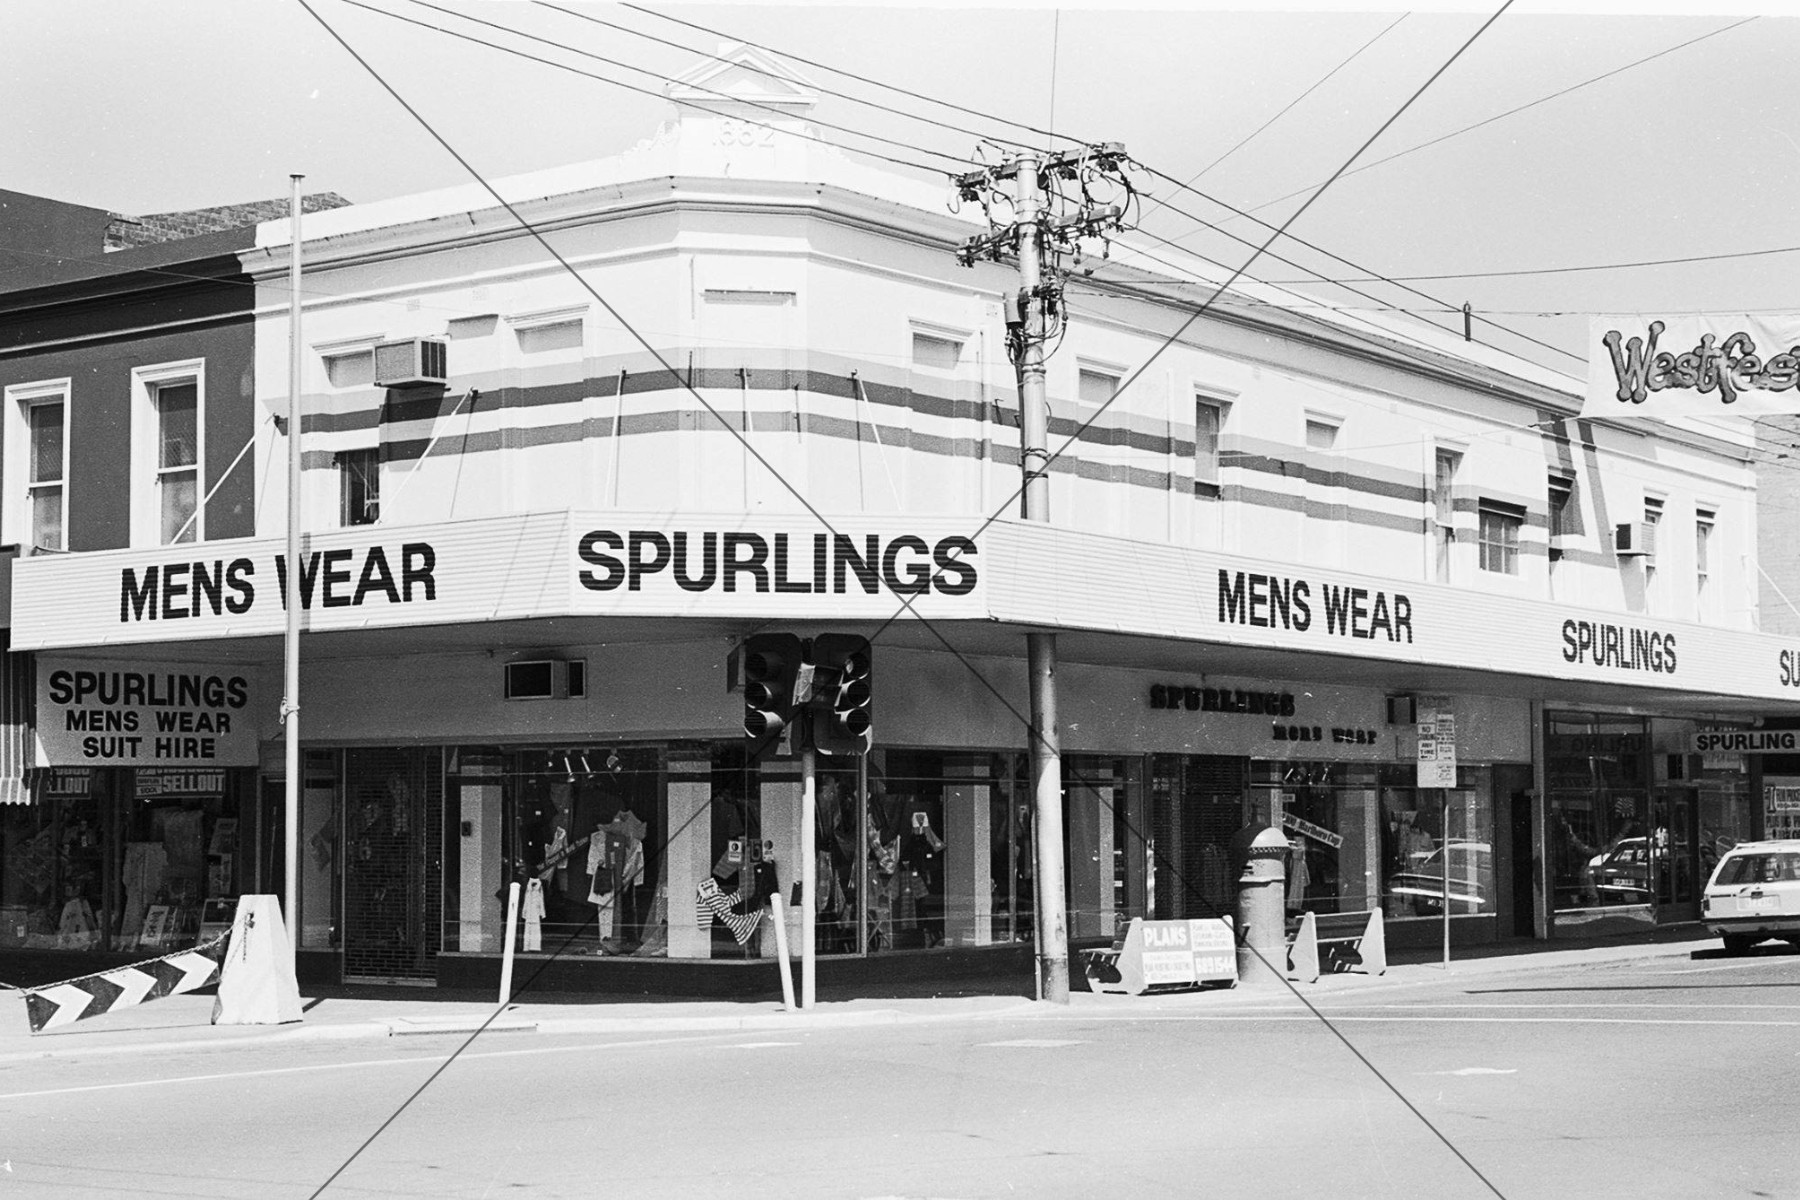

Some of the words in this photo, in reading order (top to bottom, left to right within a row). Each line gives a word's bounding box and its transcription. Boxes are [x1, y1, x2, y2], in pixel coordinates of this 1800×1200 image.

[713, 120, 774, 147] 882
[1602, 320, 1800, 404] Westfes
[578, 530, 978, 596] SPURLINGS
[121, 557, 255, 622] MENS
[275, 542, 437, 611] WEAR
[1219, 569, 1312, 632] MENS
[1322, 583, 1413, 643] WEAR
[1563, 619, 1677, 673] SPURLINGS
[49, 670, 248, 709] SPURLINGS
[1148, 683, 1296, 716] SPURLINGS
[66, 709, 139, 732] MENS
[156, 711, 231, 734] WEAR
[83, 737, 143, 758] SUIT
[155, 737, 216, 759] HIRE
[1696, 732, 1796, 751] SPURLING
[162, 774, 225, 792] SELLOUT
[1143, 926, 1187, 947] PLANS
